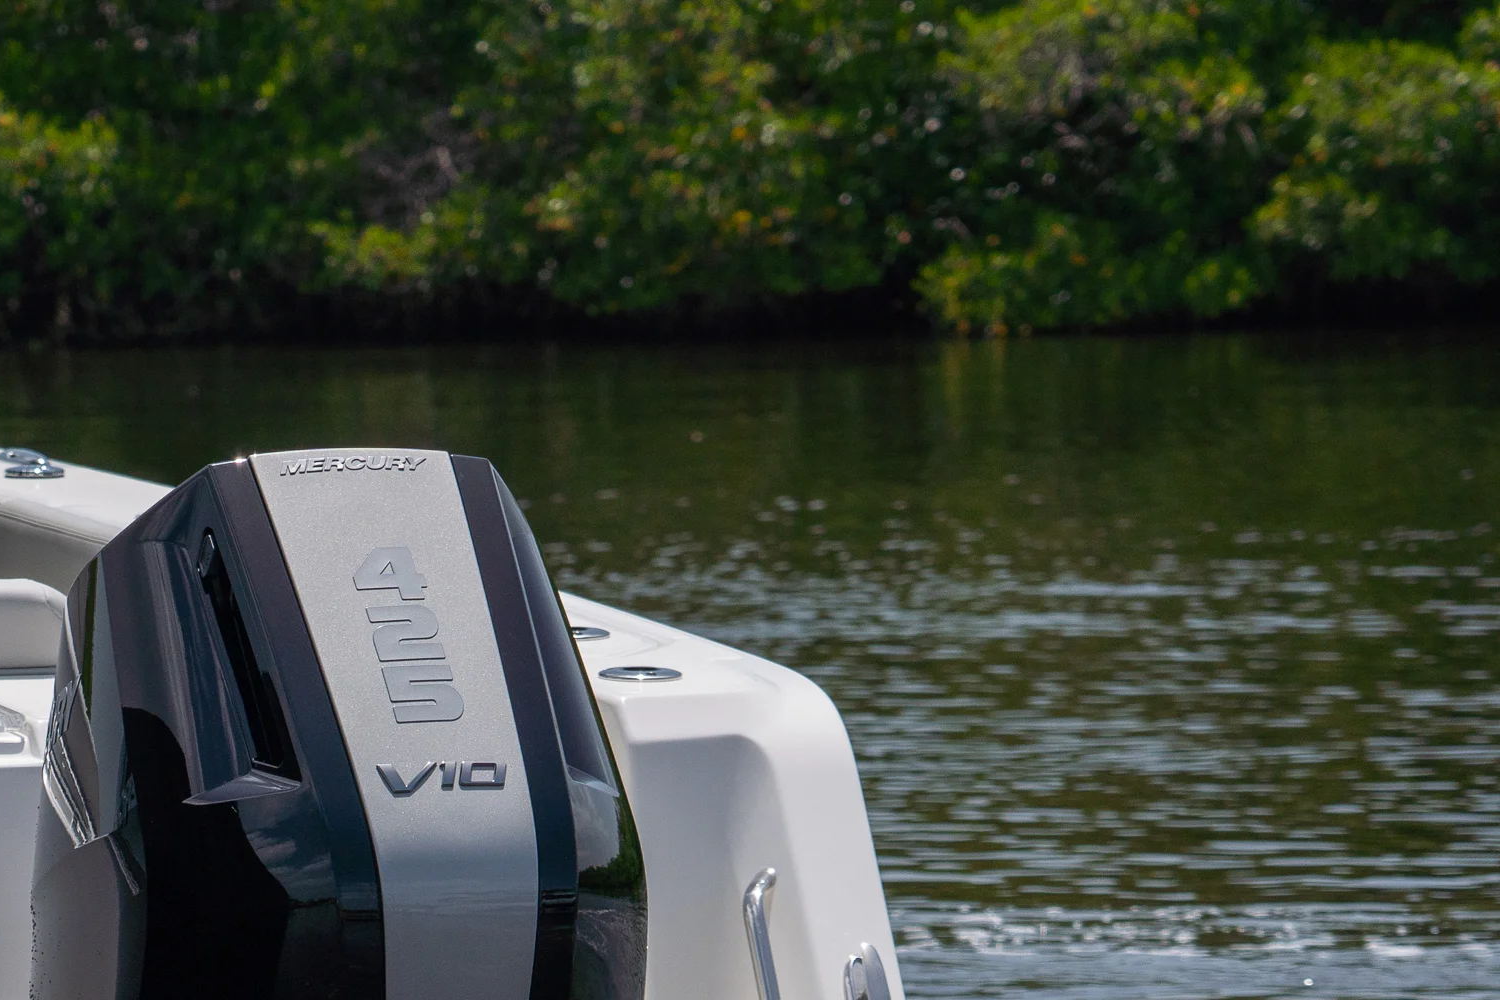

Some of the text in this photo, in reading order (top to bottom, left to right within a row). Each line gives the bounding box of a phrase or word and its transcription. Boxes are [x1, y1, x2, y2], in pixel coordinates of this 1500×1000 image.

[280, 455, 428, 477] MERCURY
[352, 546, 465, 724] 425
[376, 760, 508, 794] V10
